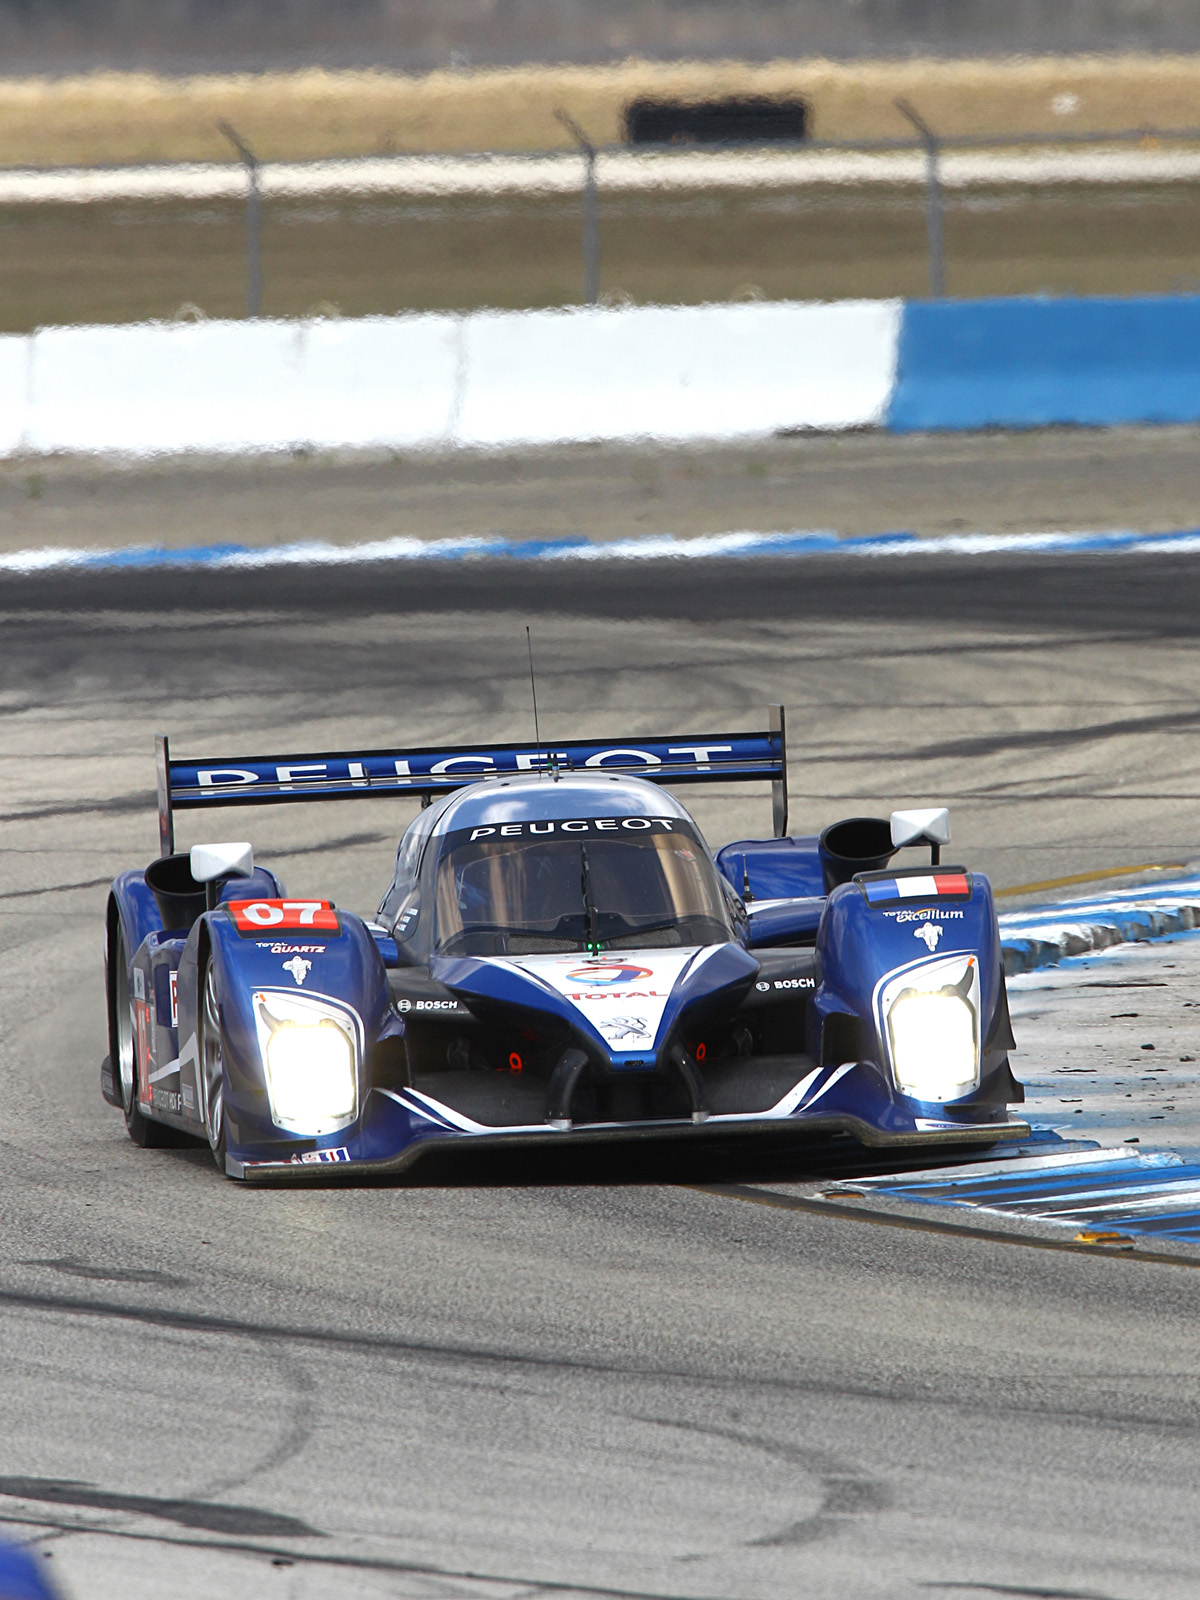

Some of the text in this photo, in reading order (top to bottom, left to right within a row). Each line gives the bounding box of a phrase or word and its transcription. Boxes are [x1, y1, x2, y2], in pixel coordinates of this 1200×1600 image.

[197, 745, 732, 795] PEUGEOT
[469, 818, 673, 841] PEUGEOT
[242, 902, 322, 926] 07
[270, 945, 326, 954] QUARTZ
[774, 978, 815, 989] BOSCH
[564, 991, 668, 1000] TOTAL
[416, 1001, 458, 1010] BOSCH
